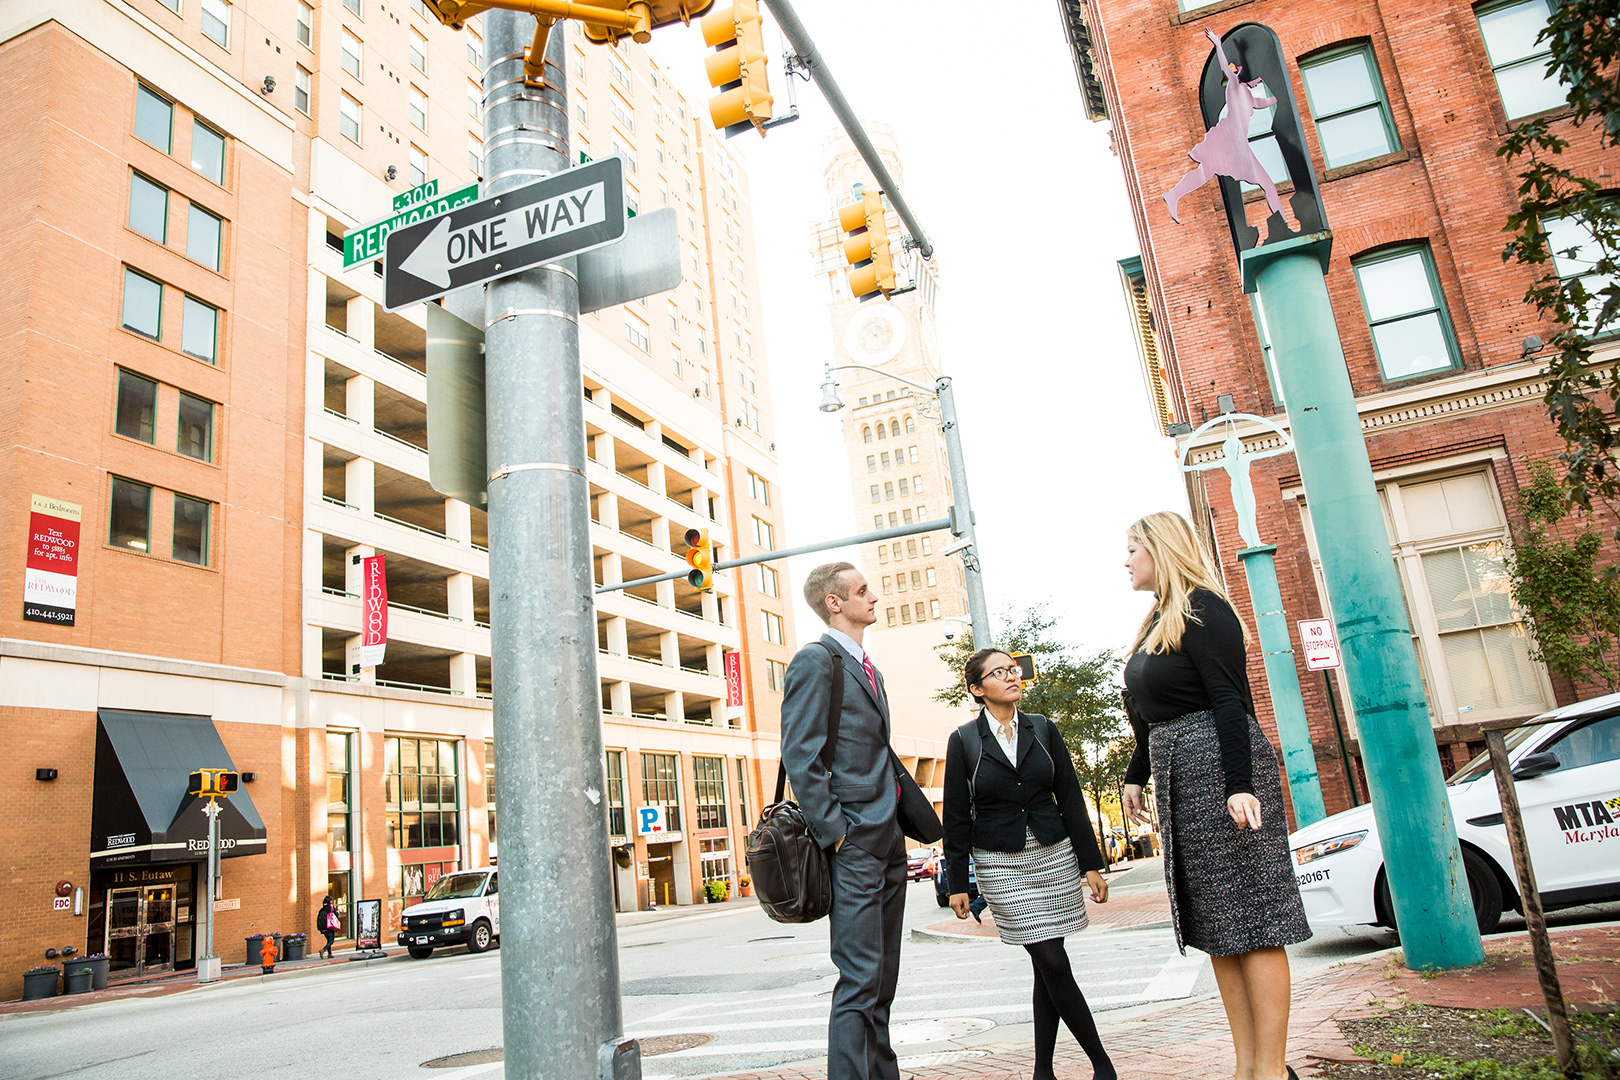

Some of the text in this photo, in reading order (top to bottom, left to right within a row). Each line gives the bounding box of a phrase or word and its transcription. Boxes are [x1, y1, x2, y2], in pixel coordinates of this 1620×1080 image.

[402, 182, 435, 207] 300
[447, 189, 594, 264] ONE WAY
[49, 502, 80, 515] Bedrooms
[48, 528, 63, 537] Text
[33, 533, 75, 547] REDWOOD
[34, 548, 73, 562] for apt. info
[28, 581, 75, 596] REDWOOD
[367, 562, 384, 645] REDWOOD
[26, 608, 74, 621] 410.441.5921
[1310, 626, 1323, 636] NO
[1305, 639, 1334, 651] STOPPING
[729, 656, 739, 706] REDWOOD
[640, 808, 659, 832] P
[1553, 800, 1614, 831] MTA
[107, 835, 135, 846] REDWOOD
[1565, 825, 1620, 844] Maryla
[188, 839, 236, 851] REDOD
[114, 870, 174, 883] 11 S. Eutaw
[55, 899, 70, 908] FDC
